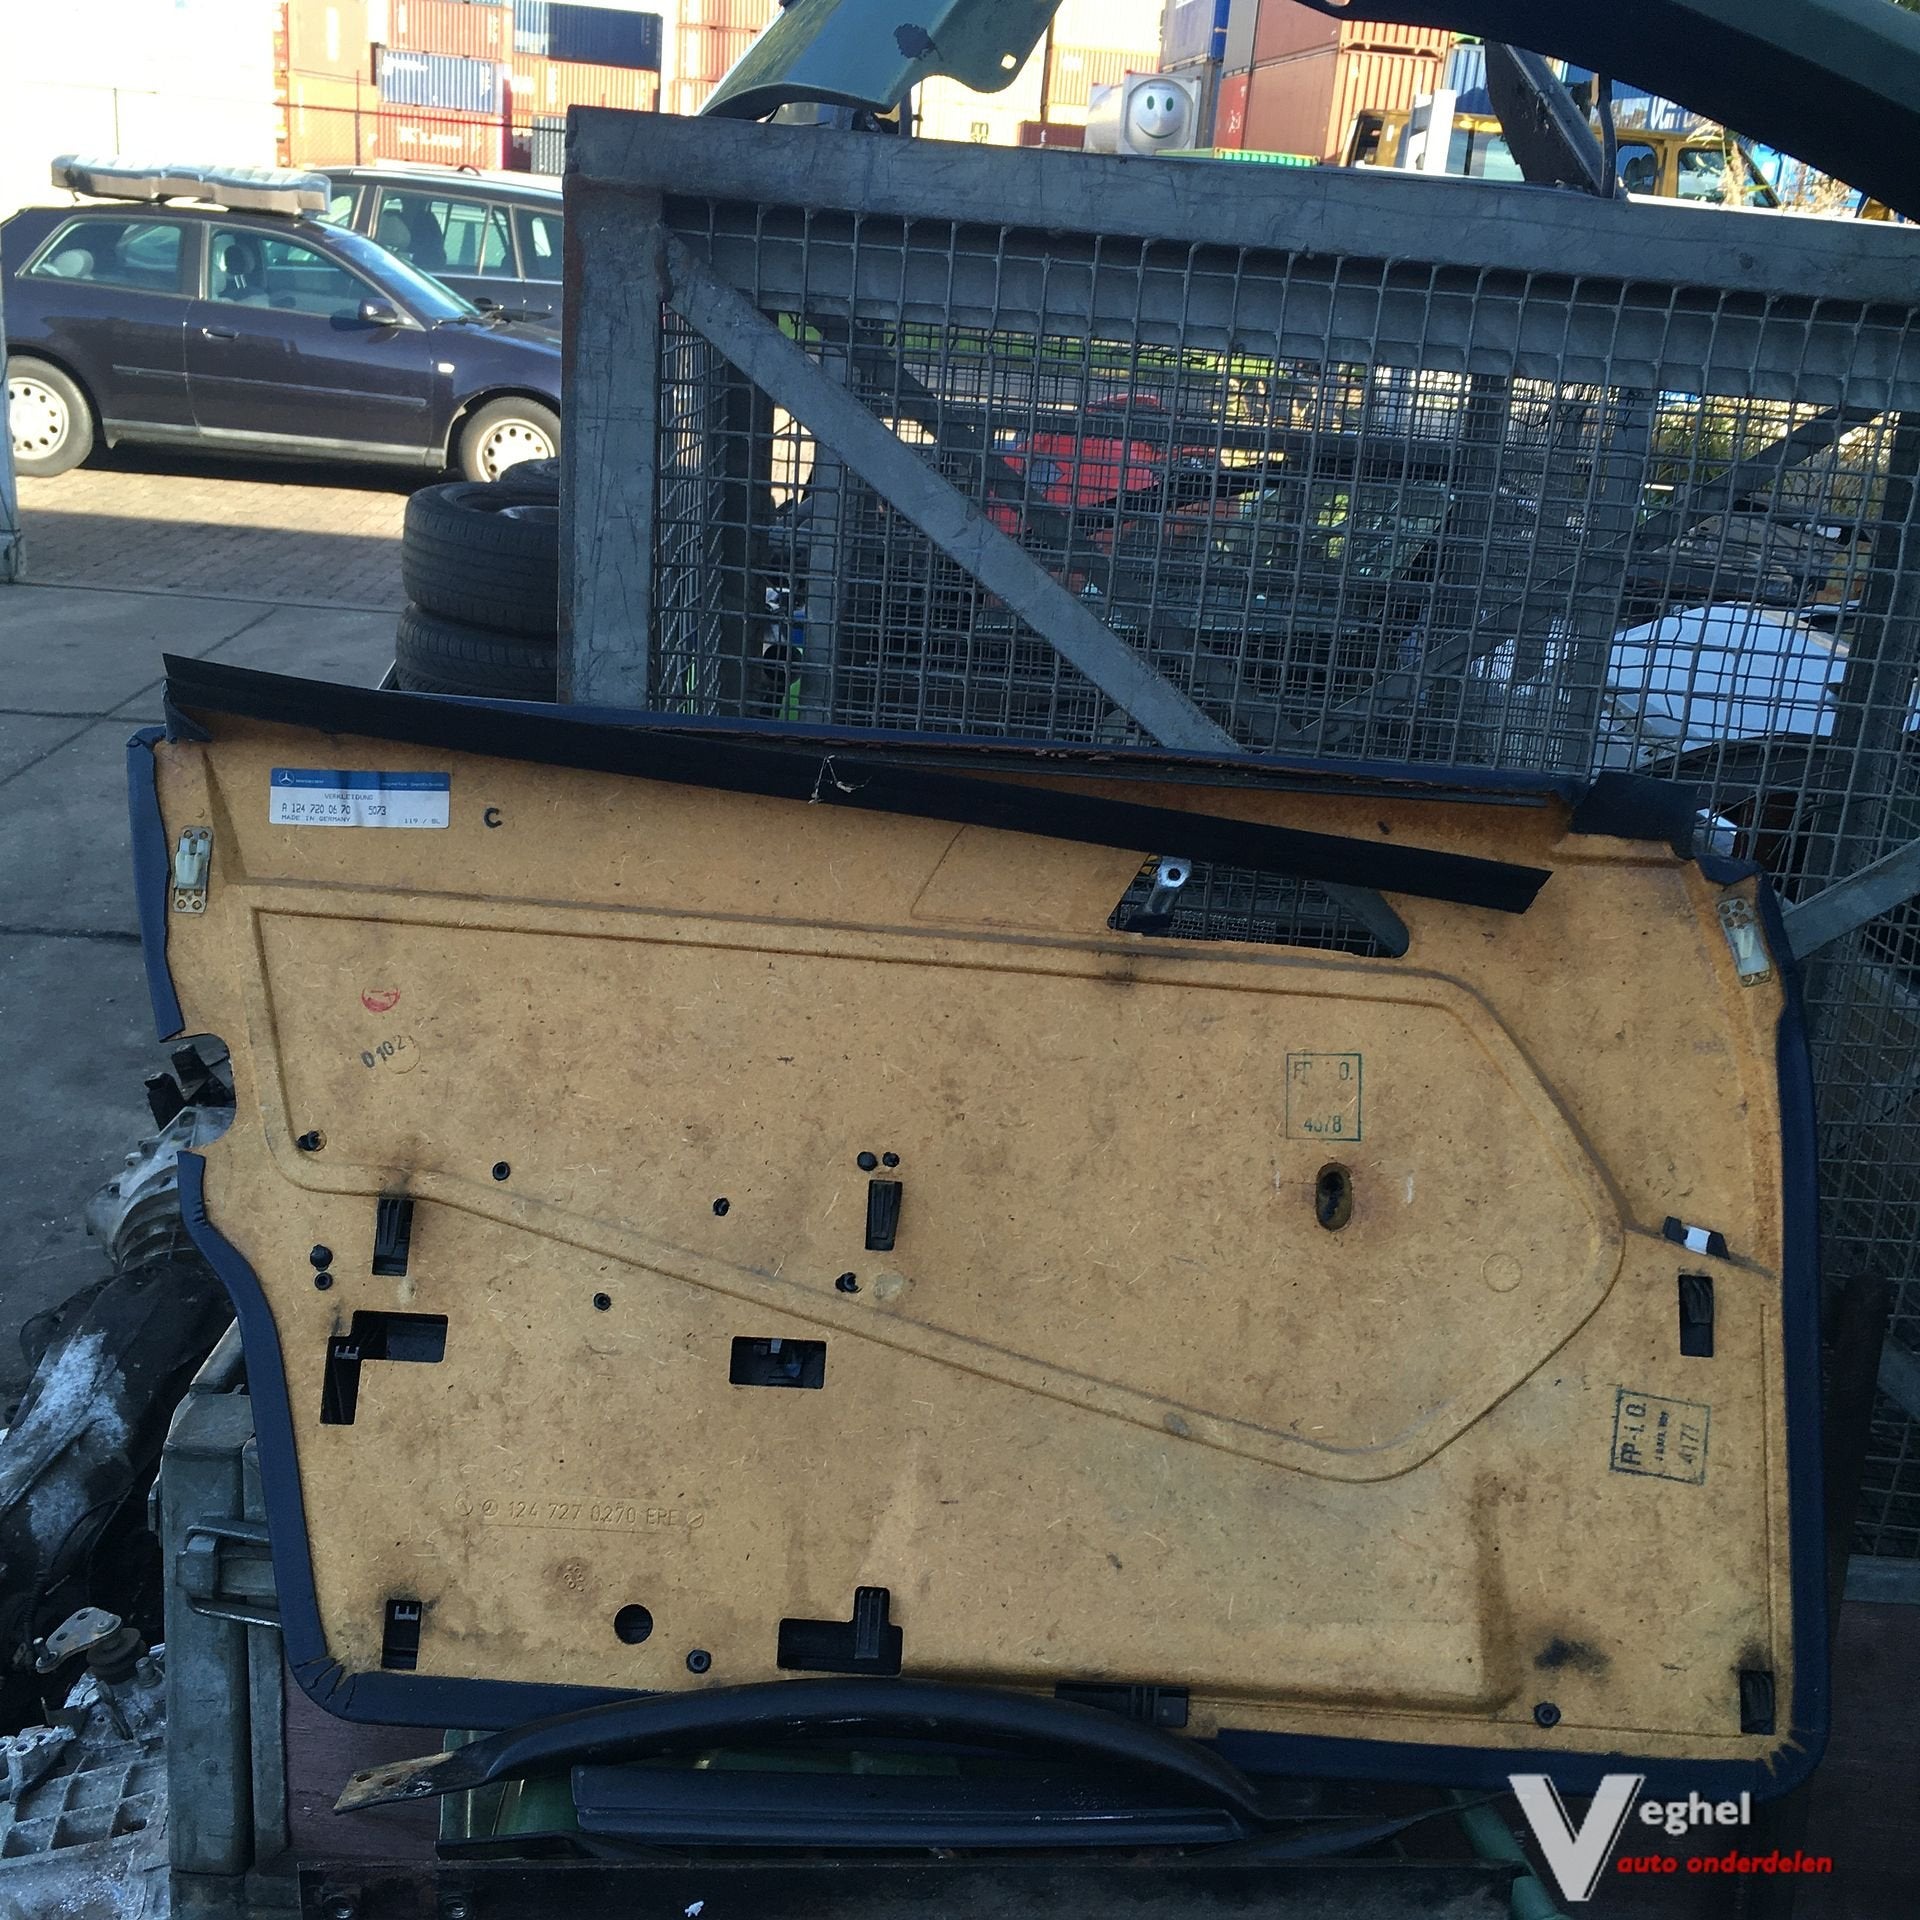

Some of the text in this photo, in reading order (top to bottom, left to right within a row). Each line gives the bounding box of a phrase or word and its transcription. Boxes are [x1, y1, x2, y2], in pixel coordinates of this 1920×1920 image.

[324, 793, 374, 801] VERKLEIDUNG
[281, 802, 288, 813] A
[292, 803, 305, 813] 124
[310, 803, 324, 814] 720
[340, 804, 351, 815] 70
[368, 805, 387, 816] 5073
[483, 807, 503, 829] C
[508, 1500, 539, 1520] 124
[547, 1502, 583, 1521] 727
